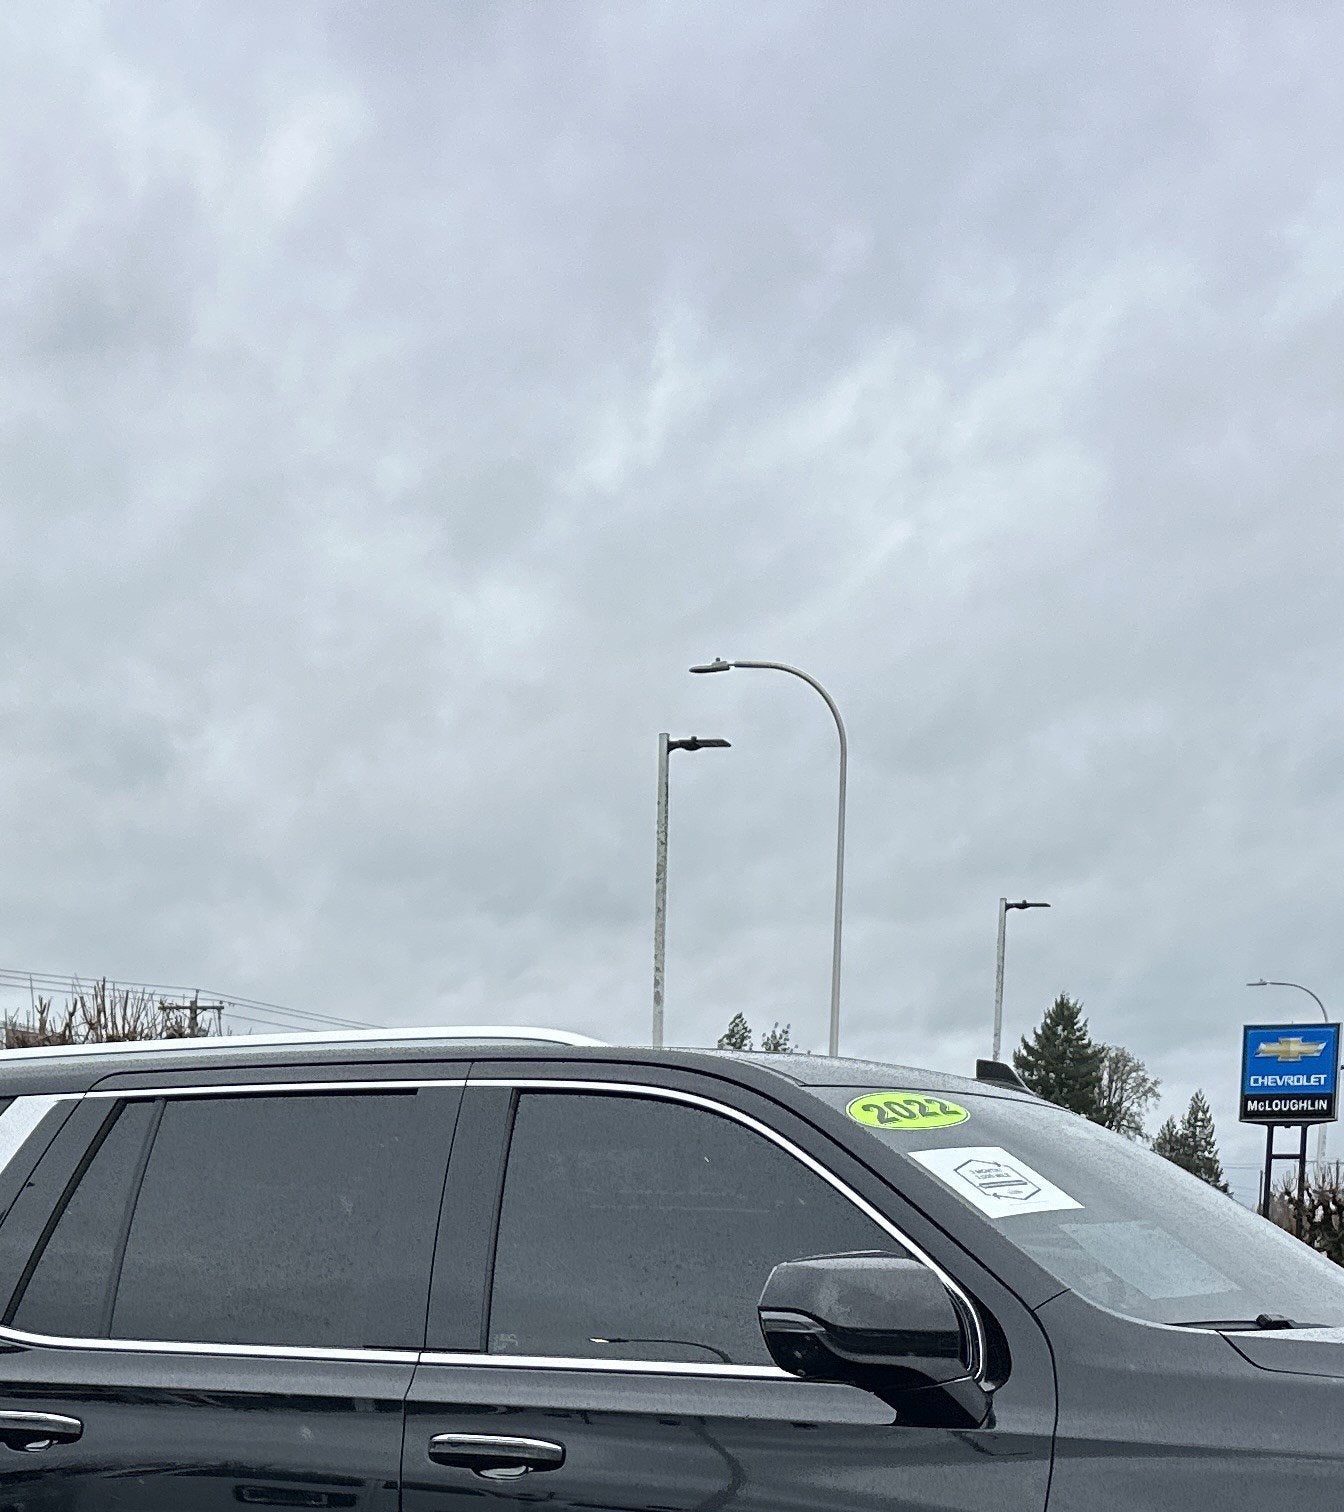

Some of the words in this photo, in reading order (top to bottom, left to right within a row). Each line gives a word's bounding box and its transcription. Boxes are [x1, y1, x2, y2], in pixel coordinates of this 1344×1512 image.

[1249, 1074, 1328, 1087] CHEVROLET
[861, 1098, 963, 1125] 2022
[1247, 1099, 1329, 1112] McLOUGHLIN
